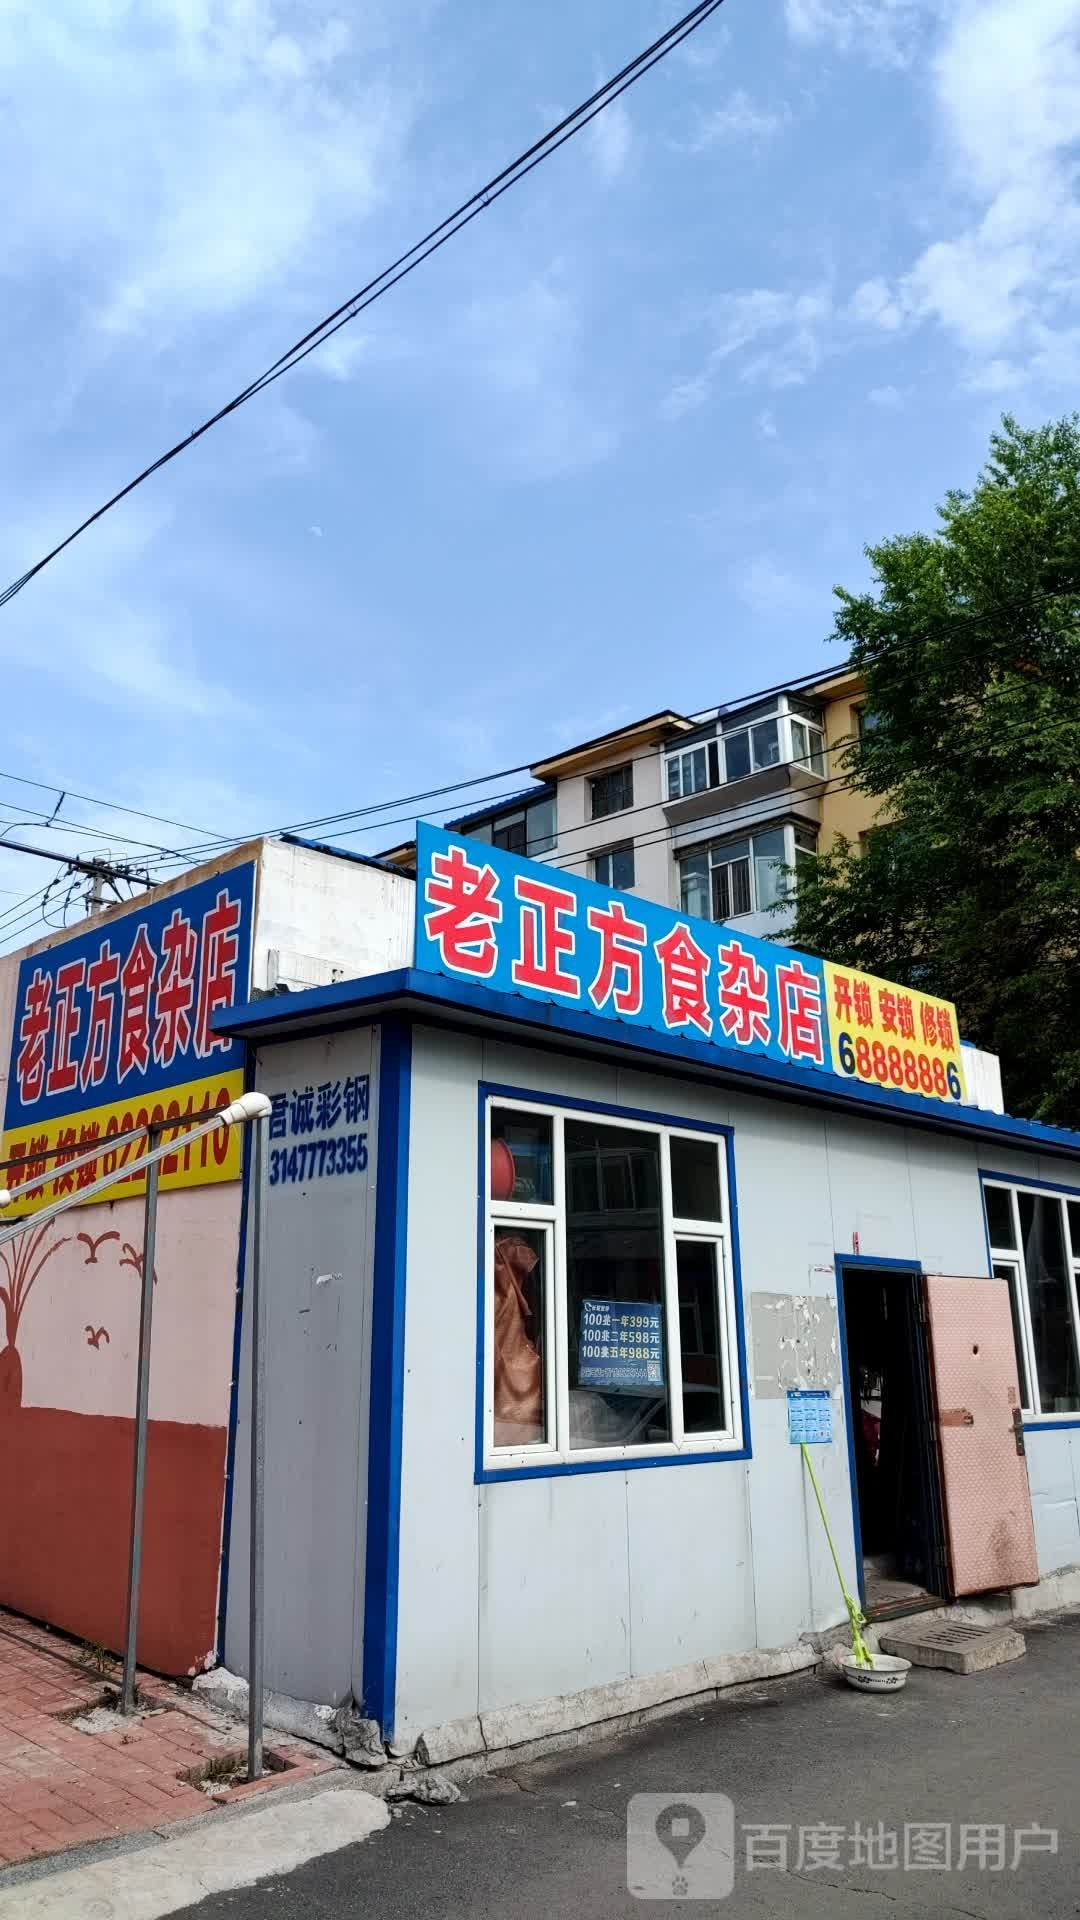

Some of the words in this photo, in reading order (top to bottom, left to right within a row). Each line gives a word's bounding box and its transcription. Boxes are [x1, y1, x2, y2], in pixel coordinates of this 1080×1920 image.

[17, 888, 242, 1106] 老正方食杂店
[424, 845, 825, 1065] 老正方食杂店
[834, 974, 874, 1029] 开锁
[878, 988, 916, 1041] 安锁
[920, 1001, 955, 1052] 修锁
[839, 1032, 961, 1100] 68888886
